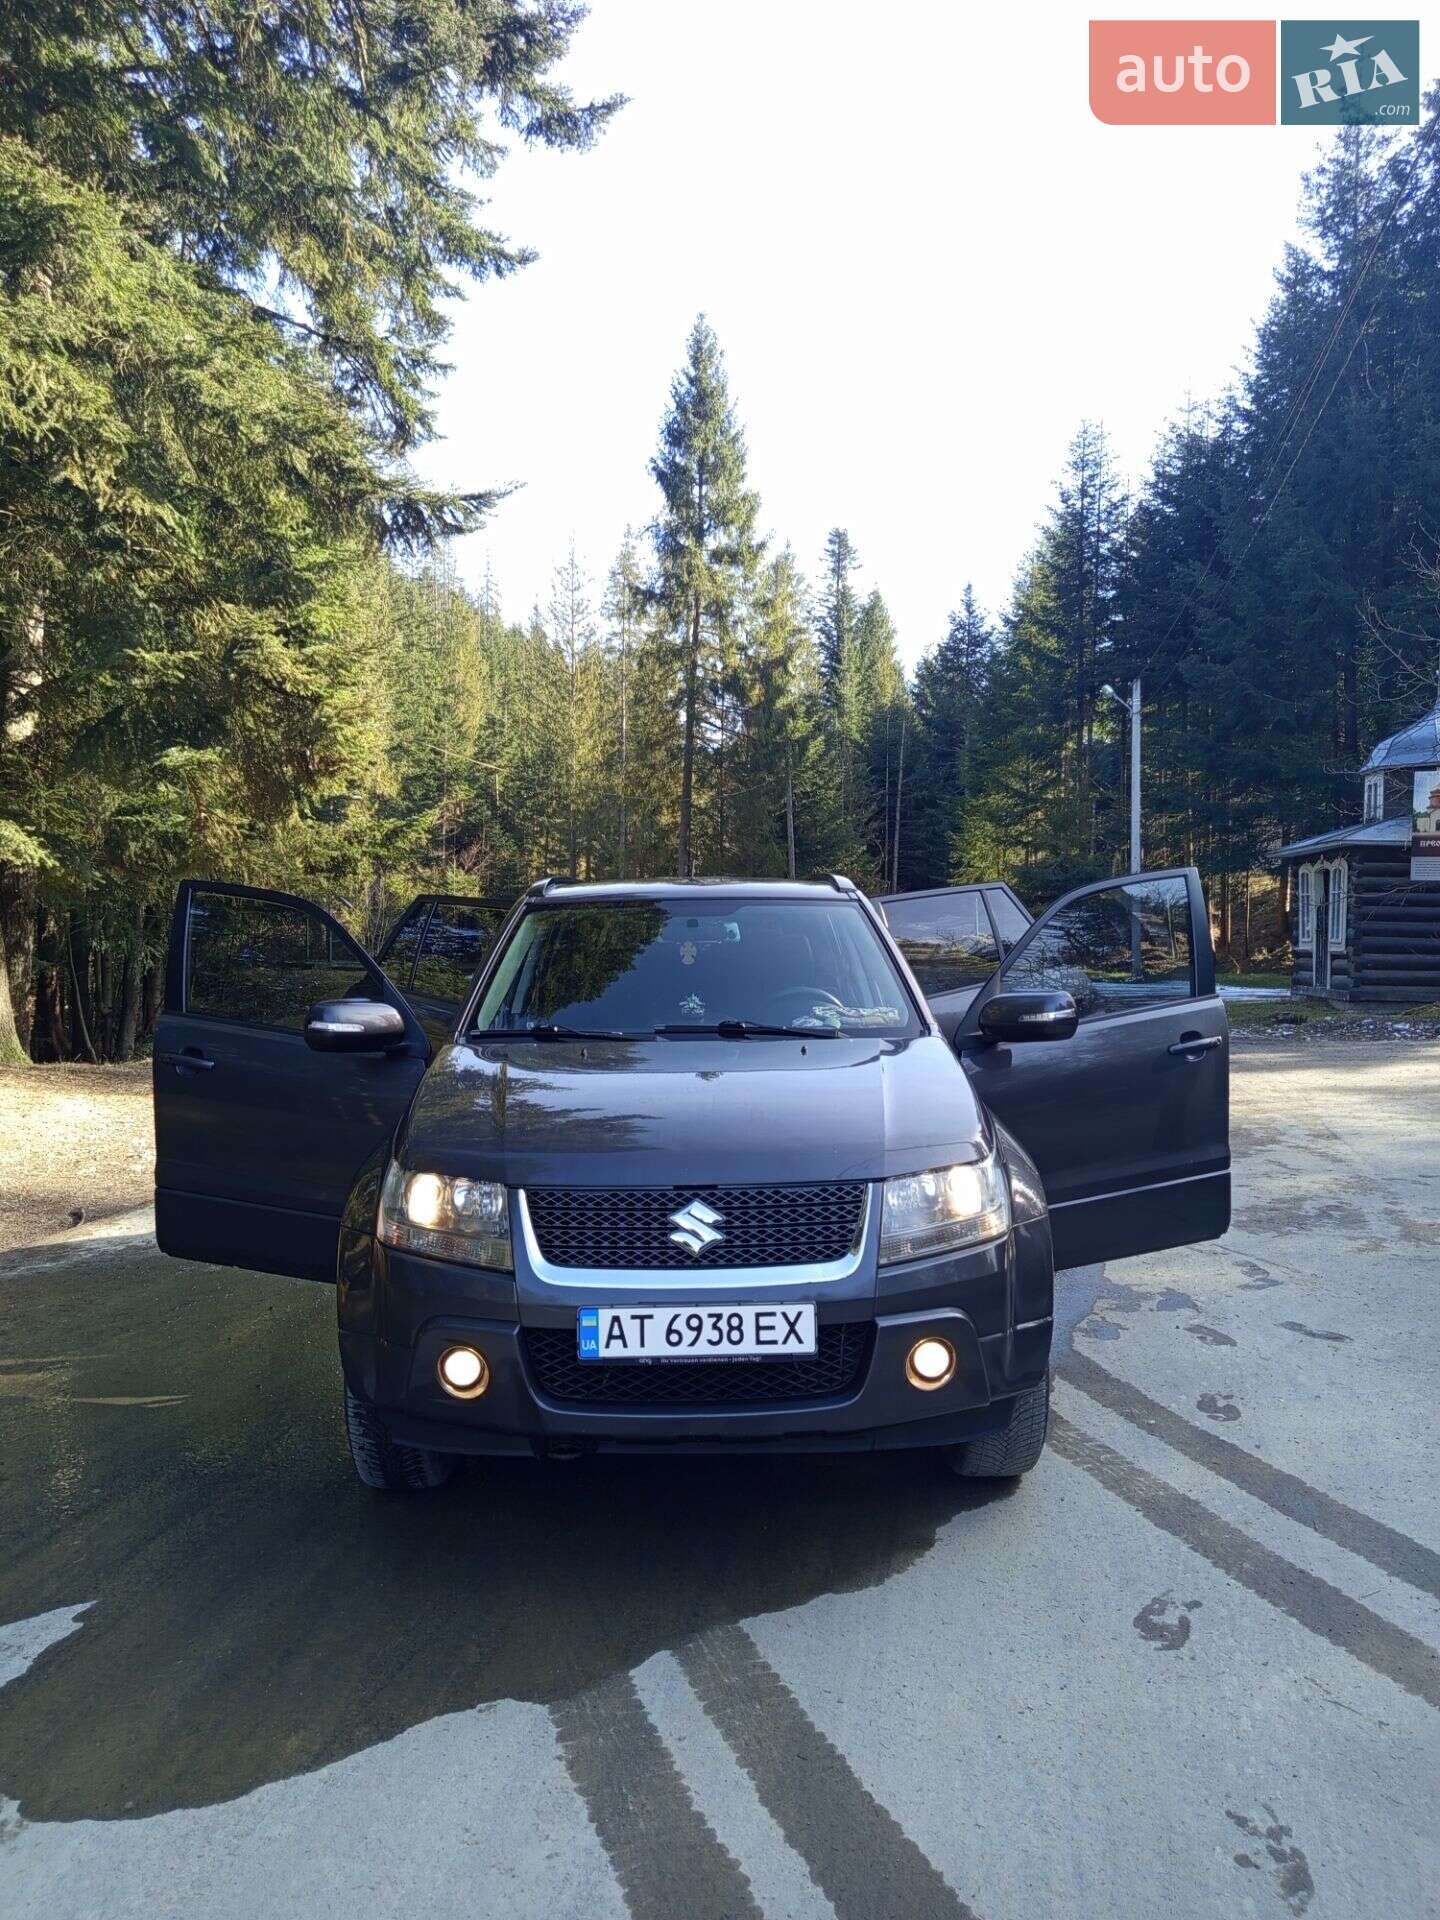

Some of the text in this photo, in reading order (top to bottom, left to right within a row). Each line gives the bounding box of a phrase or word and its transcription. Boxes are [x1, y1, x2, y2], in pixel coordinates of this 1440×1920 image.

[604, 1310, 804, 1349] AT 6938 EX
[582, 1339, 597, 1350] UA
